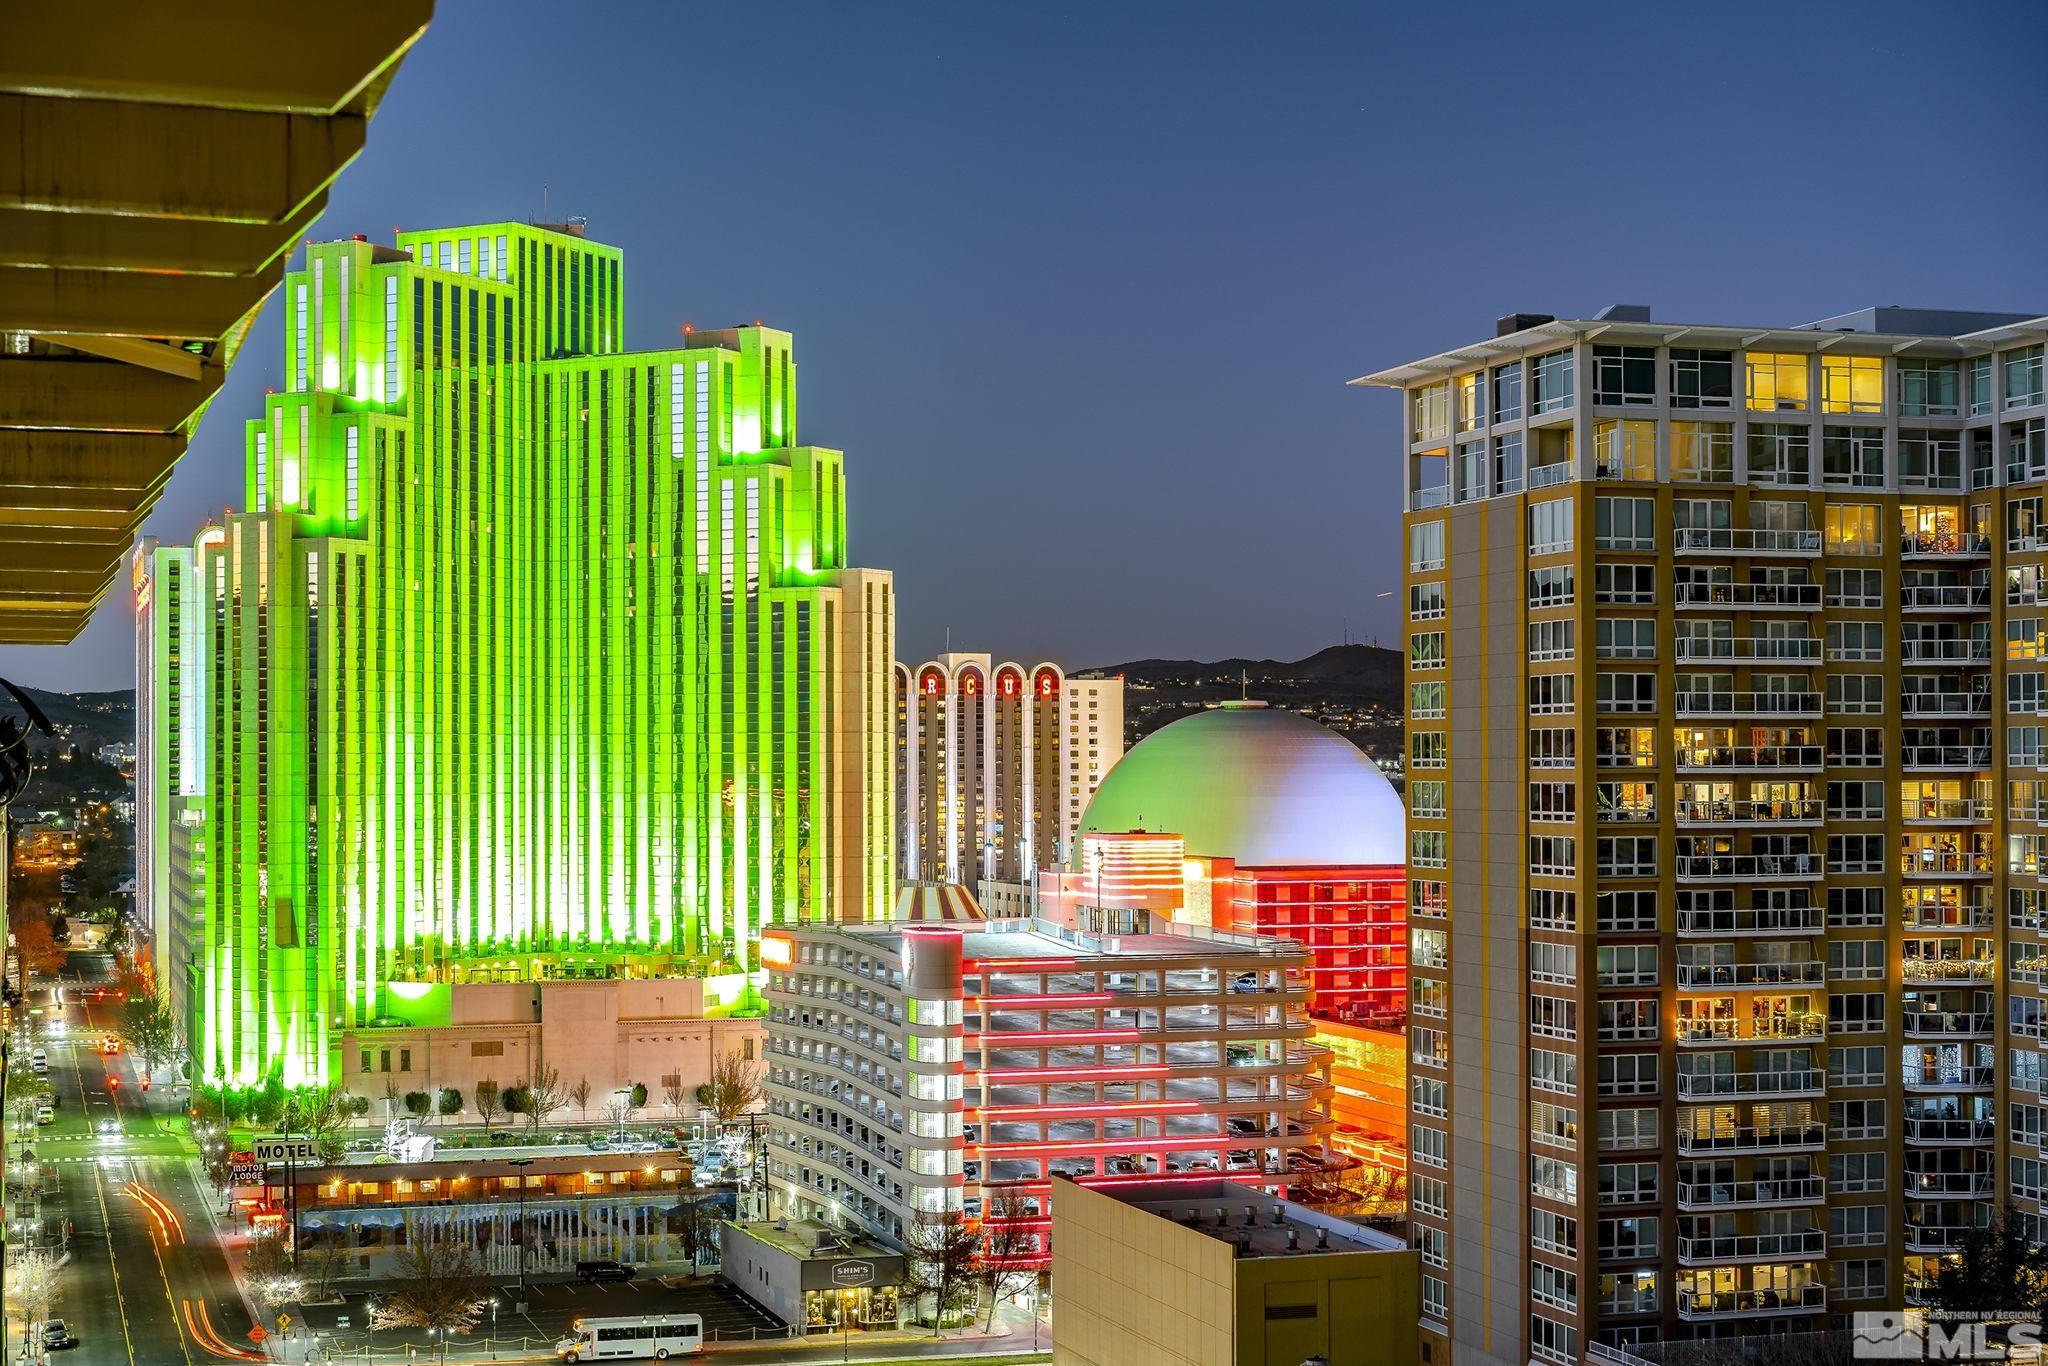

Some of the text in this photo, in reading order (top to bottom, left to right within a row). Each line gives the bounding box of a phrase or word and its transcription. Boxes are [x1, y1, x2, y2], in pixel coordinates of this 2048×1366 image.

[892, 678, 1051, 695] RCUS
[257, 1144, 316, 1159] MOTEL
[233, 1164, 264, 1173] MOTOR
[234, 1172, 264, 1181] LODGE
[837, 1266, 869, 1275] SHIM'S
